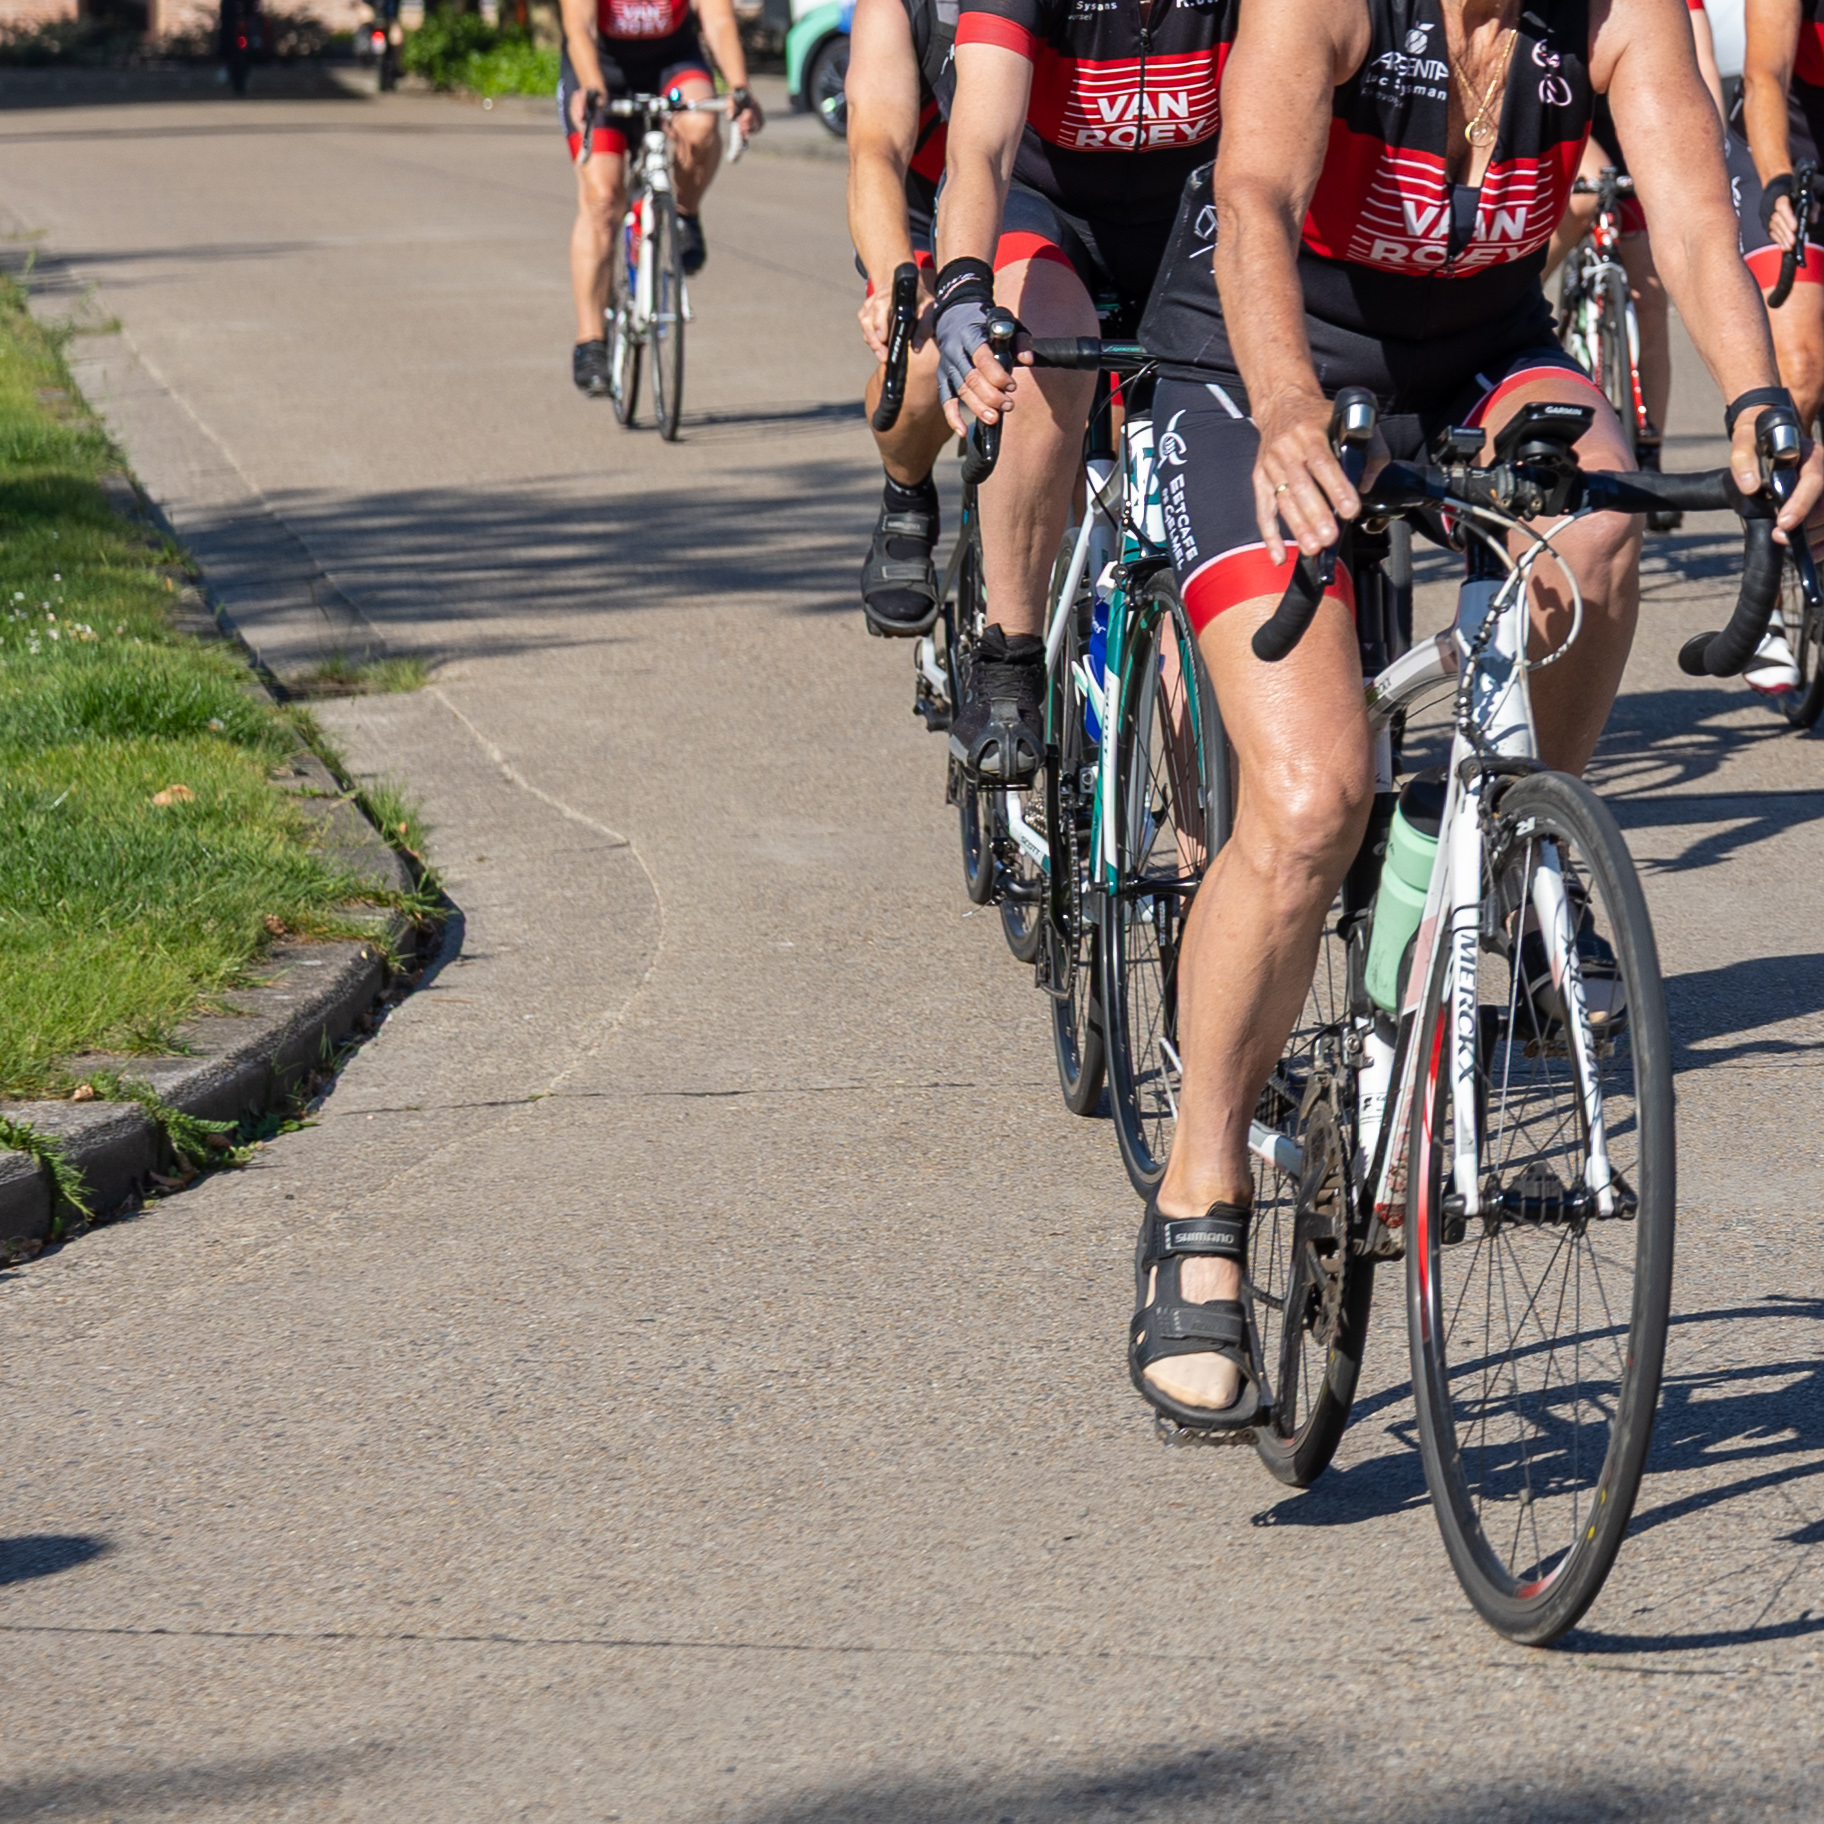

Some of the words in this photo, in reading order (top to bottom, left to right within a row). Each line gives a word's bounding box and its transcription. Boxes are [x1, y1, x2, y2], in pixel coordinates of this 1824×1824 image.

[1097, 92, 1190, 122] VAN
[1074, 120, 1208, 147] ROEY
[1402, 200, 1527, 242] VAN
[1169, 473, 1199, 562] EETCAFE
[1457, 932, 1477, 1084] MERCKX
[1174, 1231, 1235, 1246] SHIMANO
